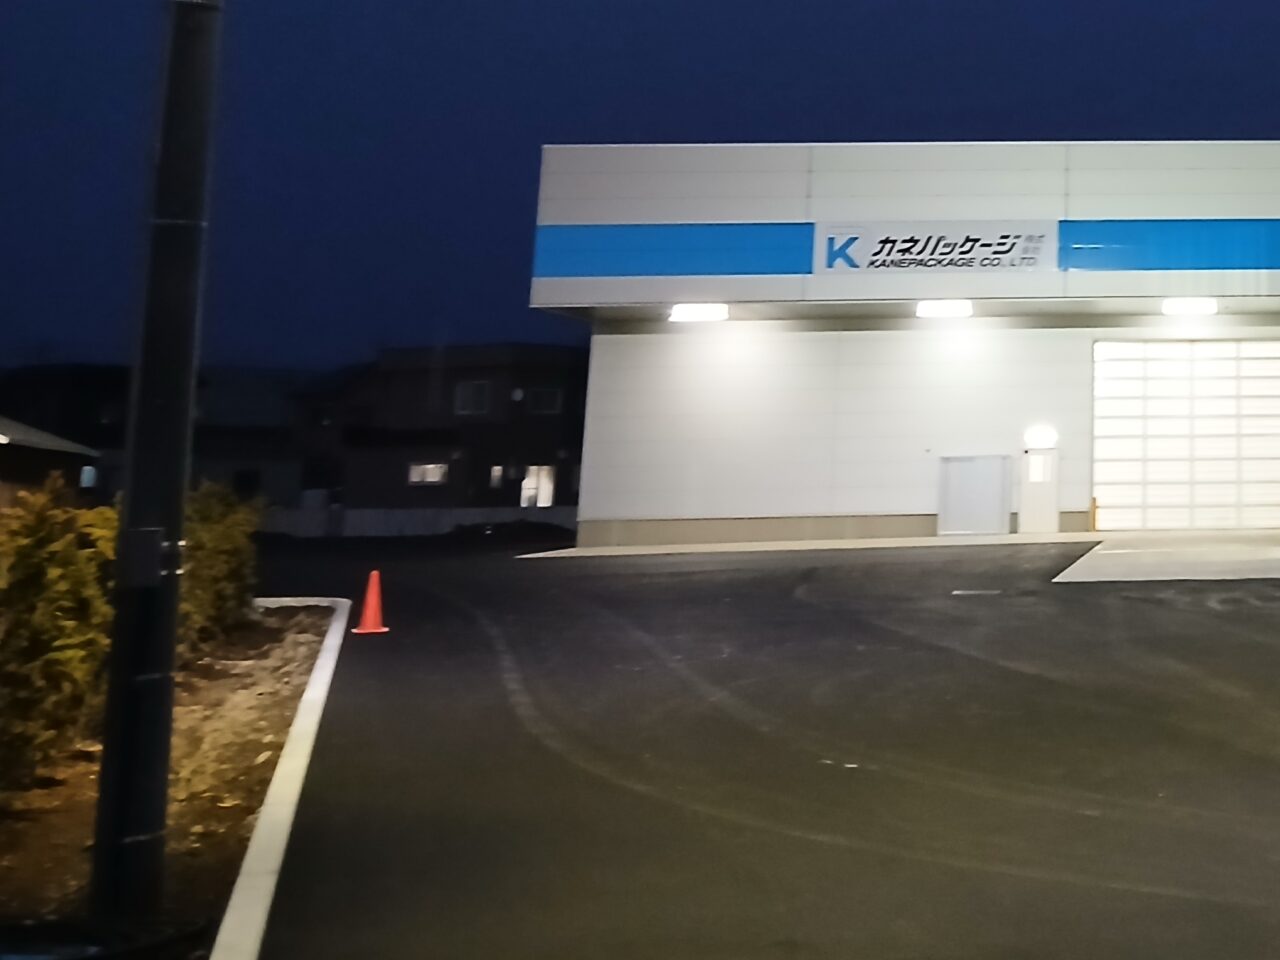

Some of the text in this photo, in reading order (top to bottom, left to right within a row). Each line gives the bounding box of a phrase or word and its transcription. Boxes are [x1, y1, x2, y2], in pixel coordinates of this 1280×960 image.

[826, 236, 860, 268] K
[871, 235, 1022, 256] カネパッケージ
[867, 257, 976, 268] KANEPACKAGE
